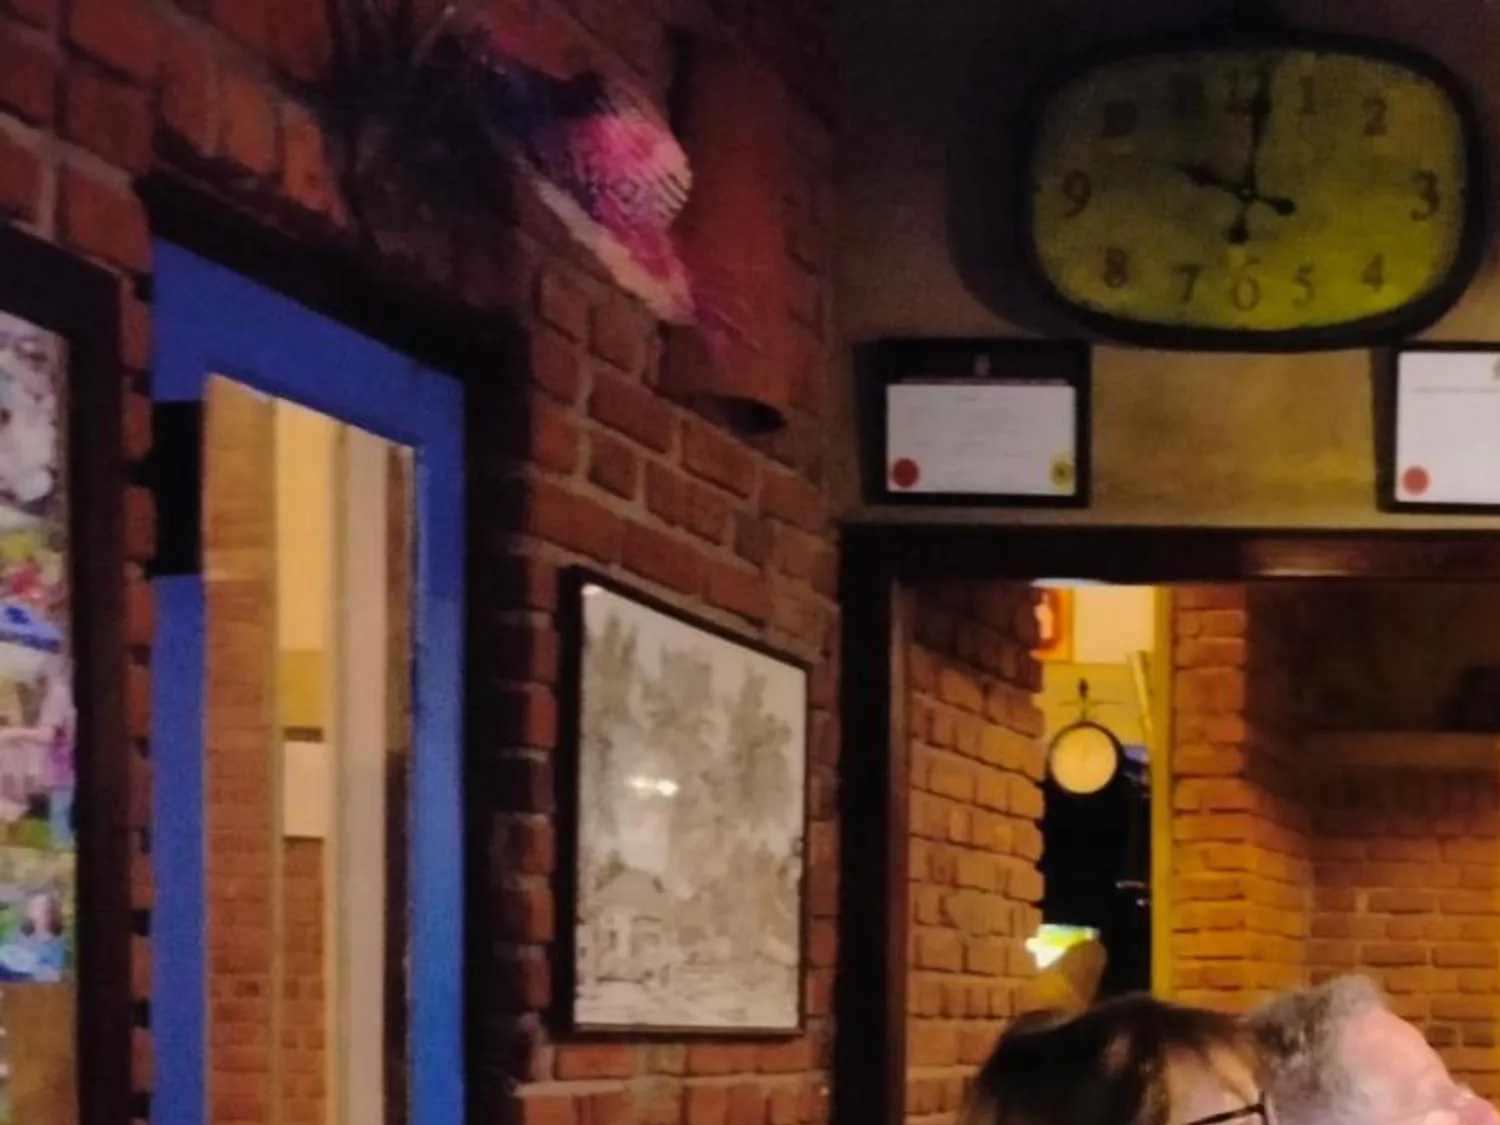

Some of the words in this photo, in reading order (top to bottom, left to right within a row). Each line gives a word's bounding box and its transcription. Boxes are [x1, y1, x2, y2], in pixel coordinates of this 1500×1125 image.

[1364, 97, 1388, 136] 2
[1063, 169, 1092, 218] 9
[1410, 170, 1440, 222] 3
[1103, 248, 1130, 288] 8
[1176, 263, 1200, 302] 7
[1293, 263, 1315, 308] 5
[1362, 254, 1386, 293] 4
